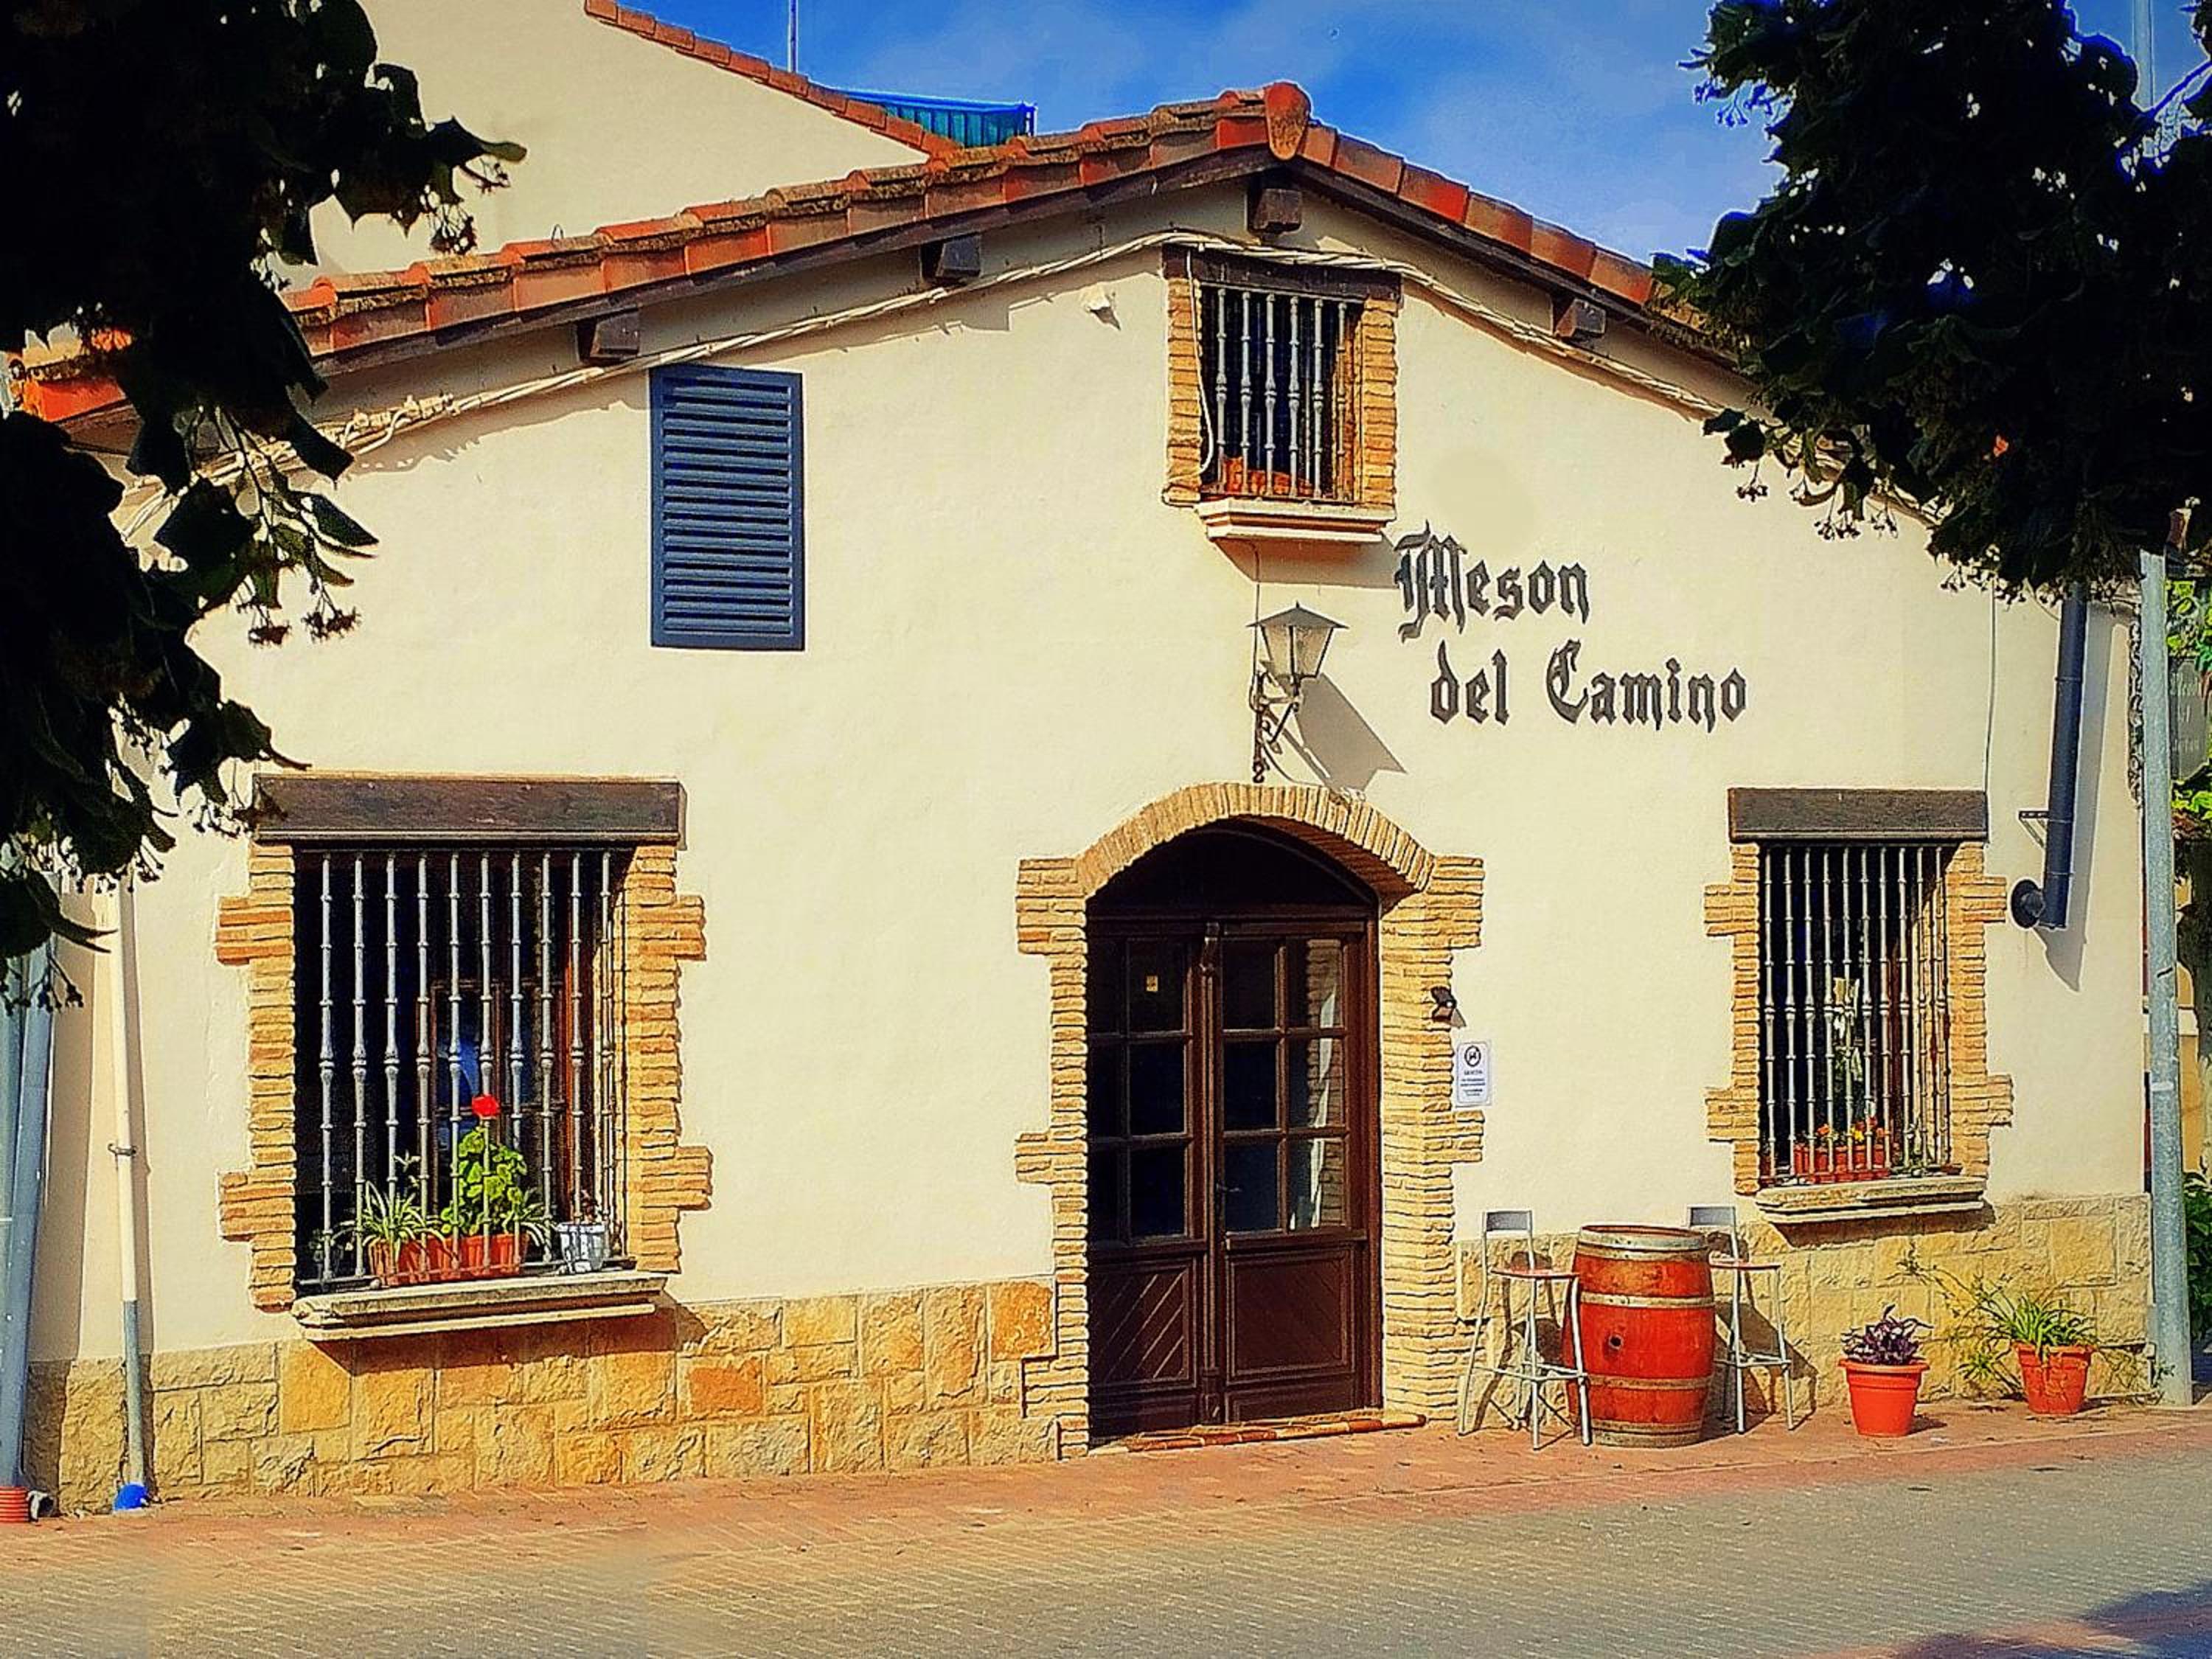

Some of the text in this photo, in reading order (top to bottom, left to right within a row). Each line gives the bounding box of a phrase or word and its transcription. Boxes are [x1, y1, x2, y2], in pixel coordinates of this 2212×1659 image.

[1394, 521, 1590, 642] Meson
[1430, 639, 1747, 732] del Camino
